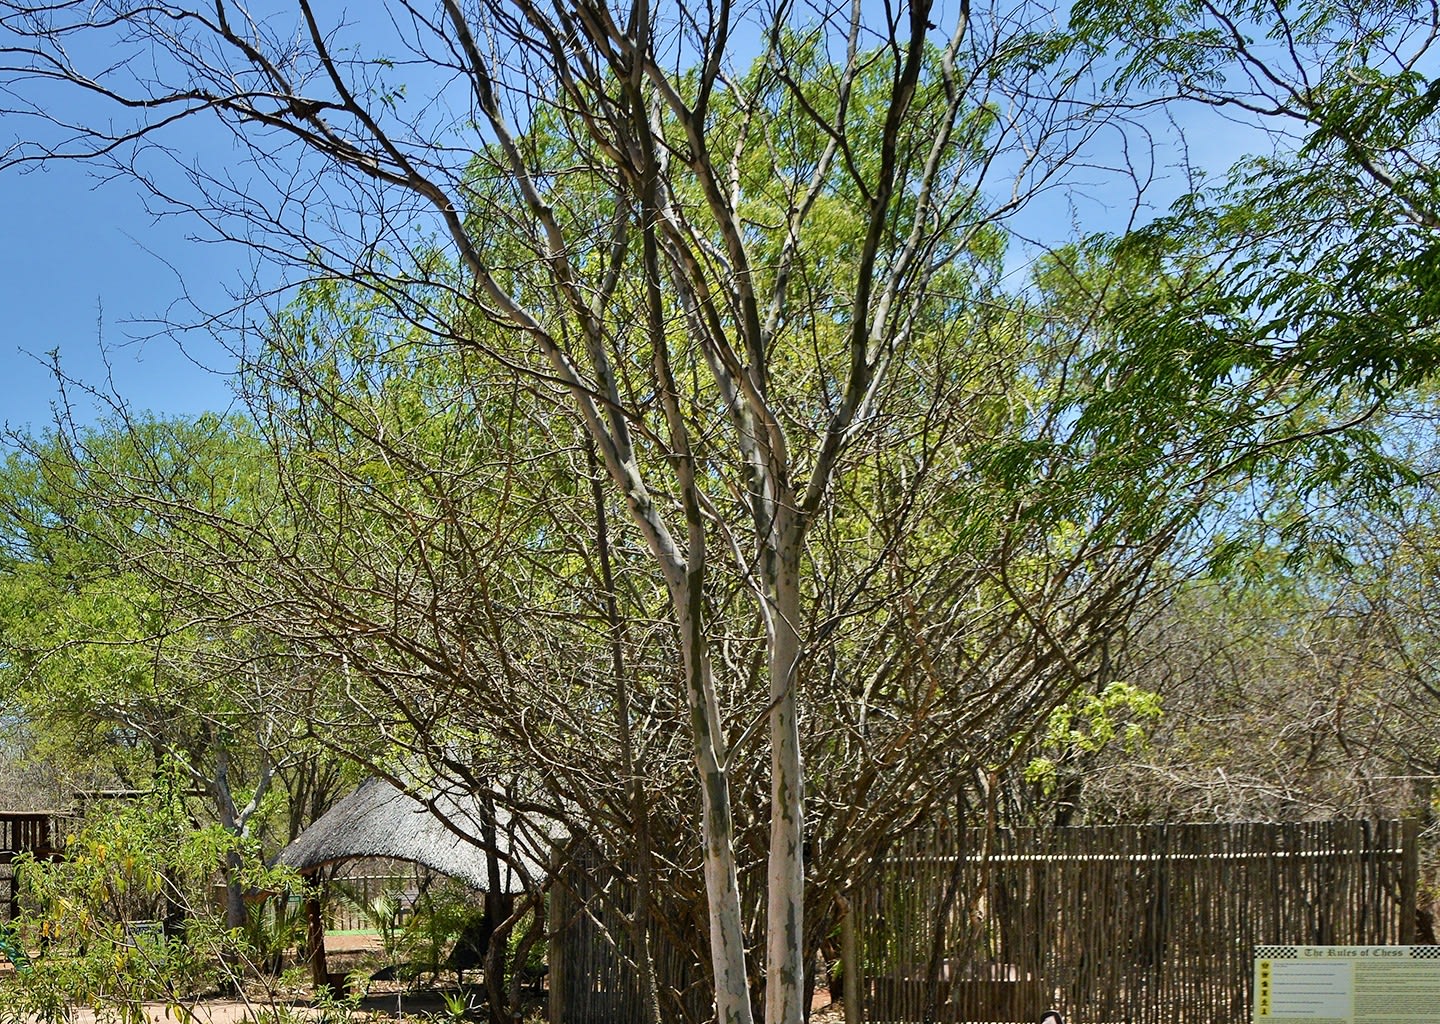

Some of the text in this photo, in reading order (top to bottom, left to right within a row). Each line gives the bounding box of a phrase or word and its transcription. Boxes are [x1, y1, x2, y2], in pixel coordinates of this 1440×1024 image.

[1304, 948, 1403, 957] The Rules of Chess
